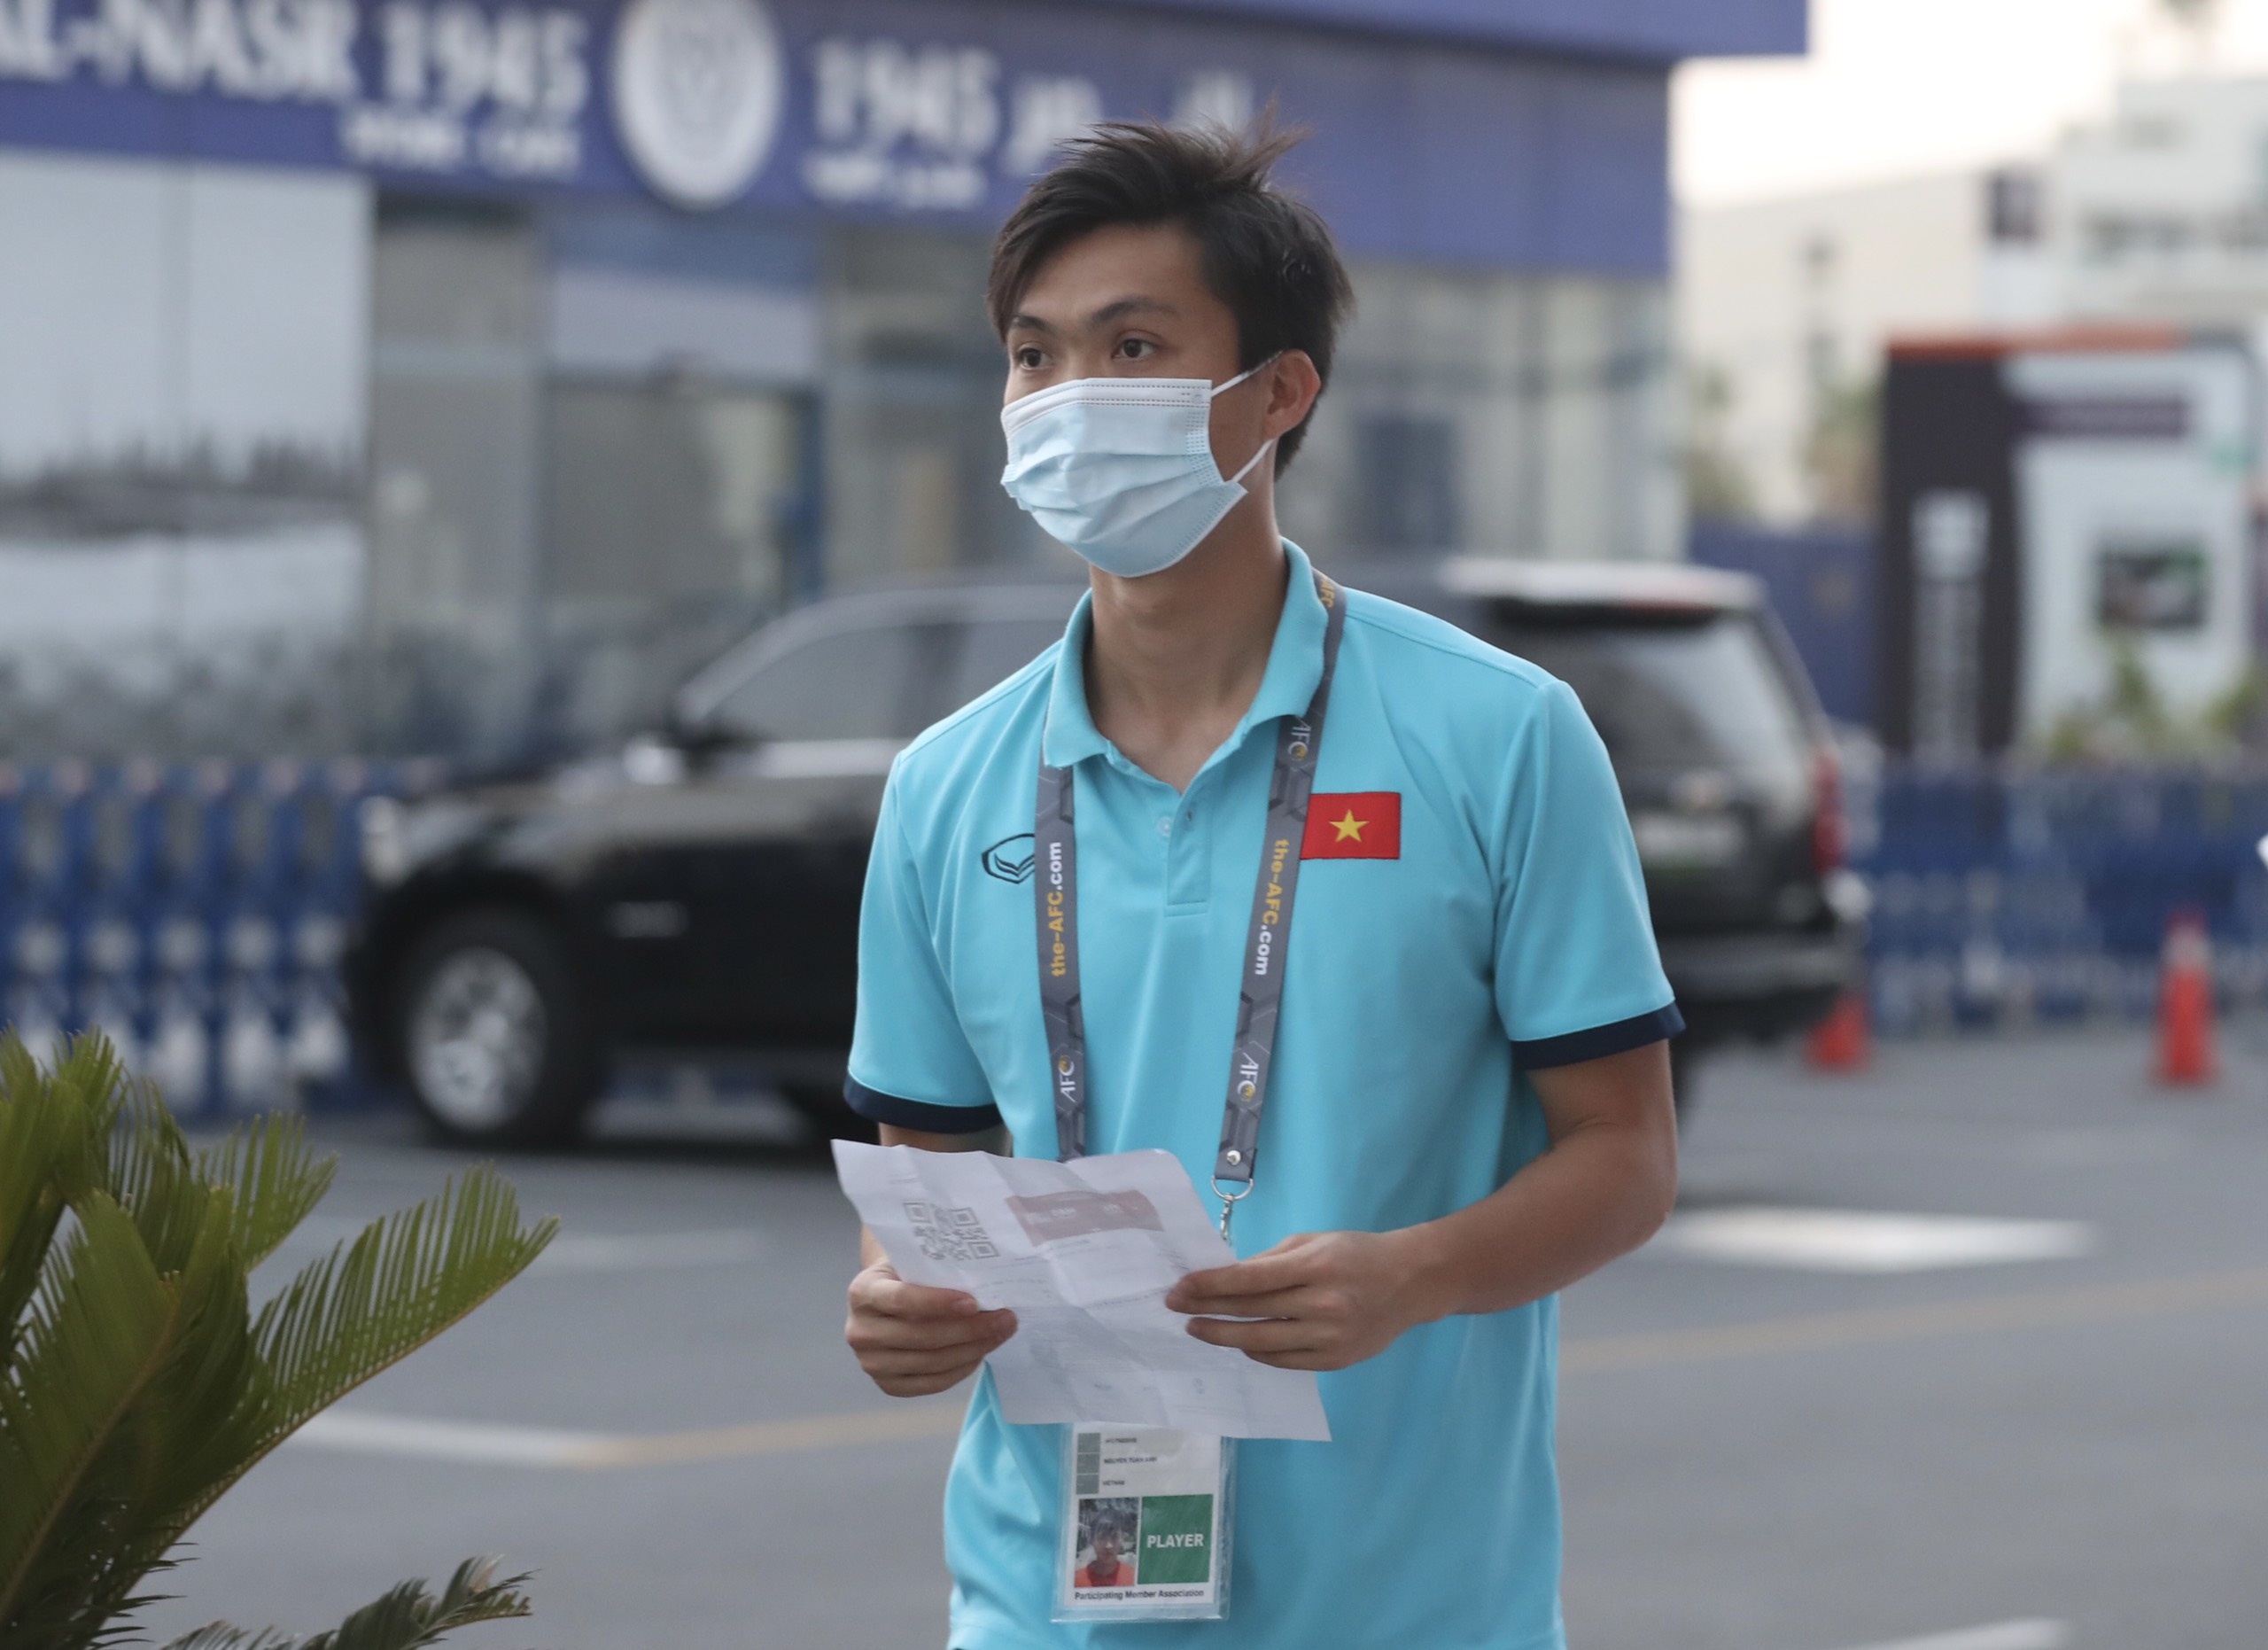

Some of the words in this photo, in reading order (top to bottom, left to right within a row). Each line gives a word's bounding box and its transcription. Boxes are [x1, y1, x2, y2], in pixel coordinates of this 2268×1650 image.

[381, 2, 590, 115] 1945
[1047, 842, 1067, 977] the-AFC.com
[1254, 838, 1290, 976] the-AFC.com
[1059, 1055, 1076, 1103] AFC
[1238, 1052, 1259, 1101] AFC
[1146, 1533, 1204, 1548] PLAYER
[1075, 1591, 1123, 1600] Participating
[1125, 1590, 1156, 1599] Member
[1158, 1589, 1204, 1599] Association
